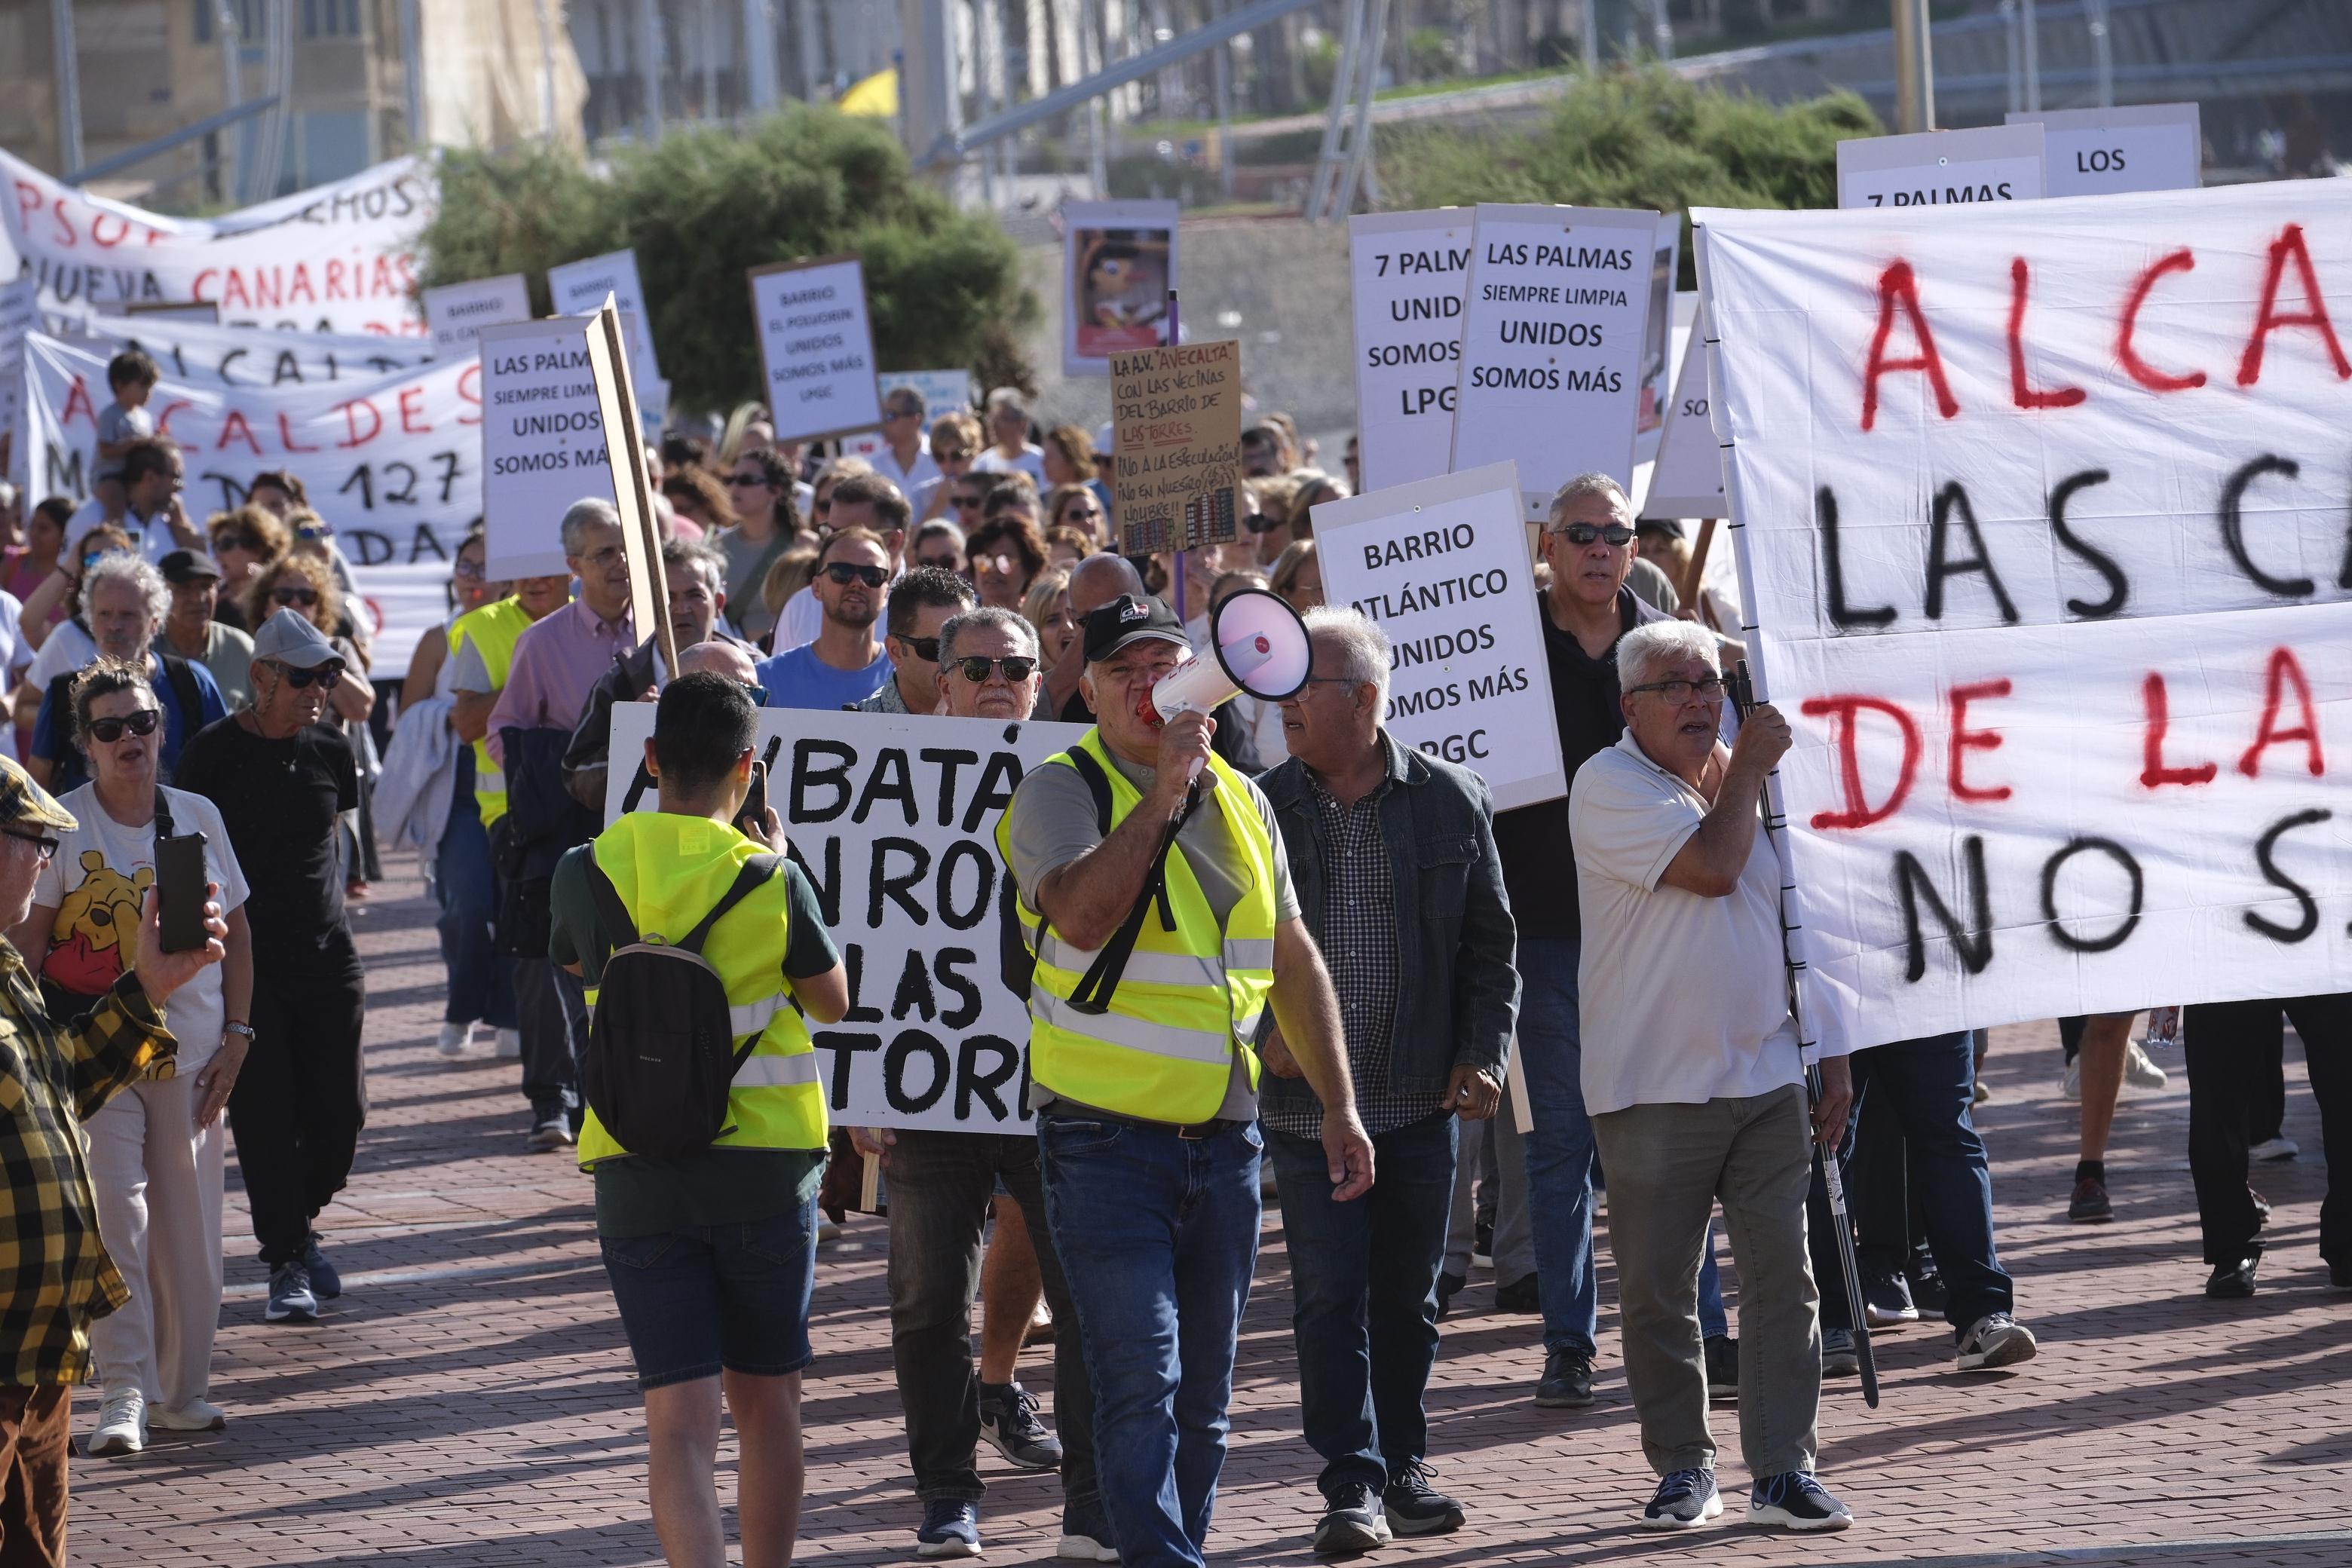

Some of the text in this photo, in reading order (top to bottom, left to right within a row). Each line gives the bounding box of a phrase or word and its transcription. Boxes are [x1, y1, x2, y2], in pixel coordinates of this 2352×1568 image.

[2078, 149, 2126, 173] LOS
[1375, 248, 1472, 277] 7 PALM
[1487, 243, 1633, 271] LAS PALMAS
[1391, 296, 1465, 322] UNID
[1482, 283, 1628, 308] SIEMPRE LIMPIA
[1500, 320, 1603, 348] UNIDOS
[1862, 222, 2352, 431] ALCA
[495, 350, 591, 375] LAS PALM
[1368, 341, 1461, 368] SOMOS
[494, 382, 598, 406] SIEMPRE LIM
[1117, 379, 1142, 400] CON
[1147, 376, 1170, 395] LAS
[1472, 365, 1622, 394] SOMOS MÁS
[63, 366, 482, 457] ACALDES
[1116, 391, 1222, 421] DEL BARRIO DE
[1402, 385, 1457, 415] LPG
[513, 410, 600, 437] UNIDOS
[1122, 424, 1144, 443] LAS
[494, 443, 610, 476] SOMOS MÁ
[1141, 455, 1151, 474] A
[1154, 454, 1168, 472] LA
[339, 450, 465, 510] 127
[1363, 523, 1475, 571] BARRIO
[1818, 453, 2352, 623] LAS C
[1384, 664, 1529, 721] OMOS MÁS
[1419, 728, 1490, 764] PGC
[1801, 645, 2326, 829] DE LA
[788, 722, 1024, 834] BATÁ
[866, 835, 1009, 931] RO
[1894, 808, 2352, 982] NO S
[841, 942, 983, 1031] LAS
